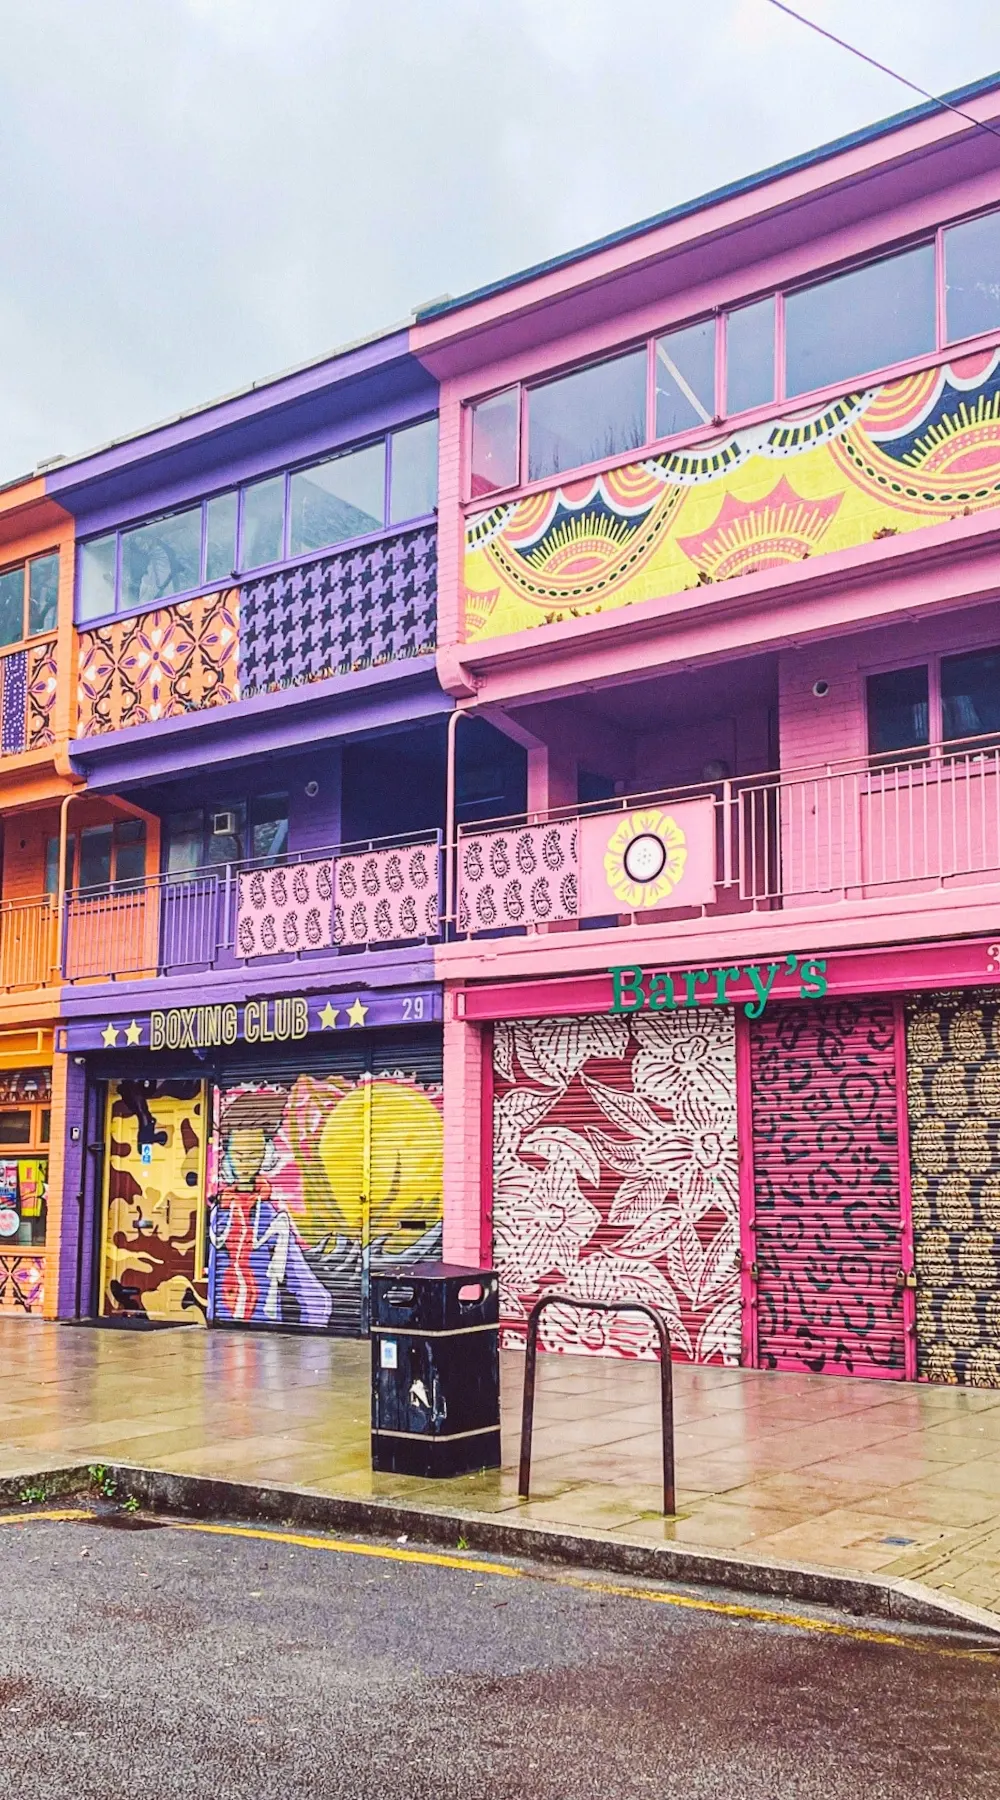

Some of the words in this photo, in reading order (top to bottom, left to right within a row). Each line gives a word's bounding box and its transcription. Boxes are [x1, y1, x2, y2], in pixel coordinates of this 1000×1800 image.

[402, 996, 424, 1021] 29
[608, 954, 828, 1019] Barry's
[150, 1004, 238, 1051] BOXING
[244, 998, 309, 1043] CLUB
